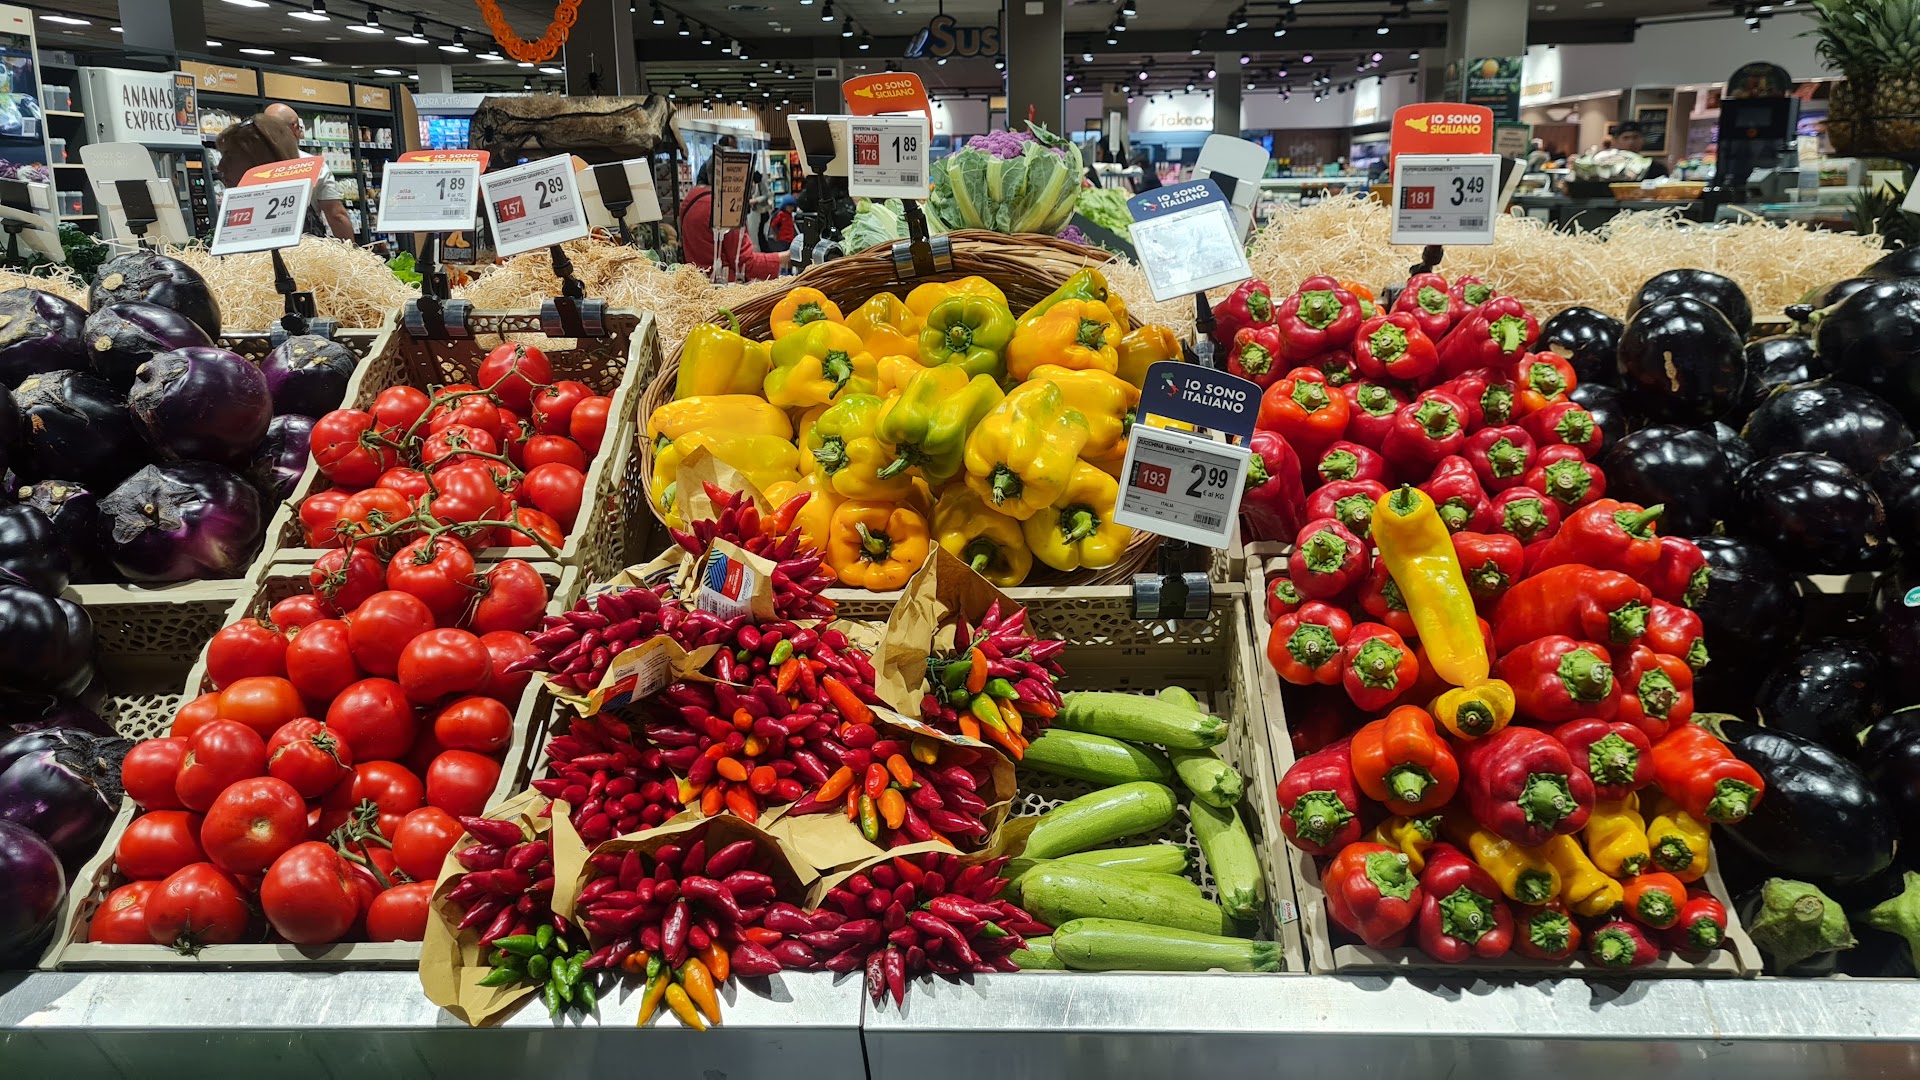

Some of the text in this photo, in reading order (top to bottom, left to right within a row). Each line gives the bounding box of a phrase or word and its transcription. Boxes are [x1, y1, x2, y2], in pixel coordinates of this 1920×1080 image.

[872, 80, 912, 91] IO SONO
[122, 84, 174, 110] ANANAS
[420, 96, 440, 106] SENZA
[875, 88, 915, 99] SICILIANO
[124, 110, 177, 132] EXPRESS
[1431, 114, 1482, 124] IO SONO
[1430, 124, 1482, 135] SICILIANO
[854, 134, 878, 143] PROMO
[861, 150, 877, 160] 178
[892, 136, 917, 163] 1 89
[271, 166, 313, 179] SICILIANO
[286, 160, 315, 171] SONO
[436, 177, 466, 200] 1 89
[534, 176, 564, 210] 2 89
[1157, 185, 1206, 202] IO SONO
[1450, 176, 1484, 206] 3 49
[1160, 190, 1210, 209] ITALIANO
[1410, 192, 1430, 204] 181
[264, 195, 295, 220] 2 49
[502, 202, 521, 216] 157
[232, 212, 251, 222] 172
[1185, 379, 1247, 402] IO SONO
[1182, 390, 1244, 413] ITALIANO
[1142, 469, 1166, 487] 193
[1186, 464, 1229, 498] 2 99
[1215, 492, 1225, 500] KG
